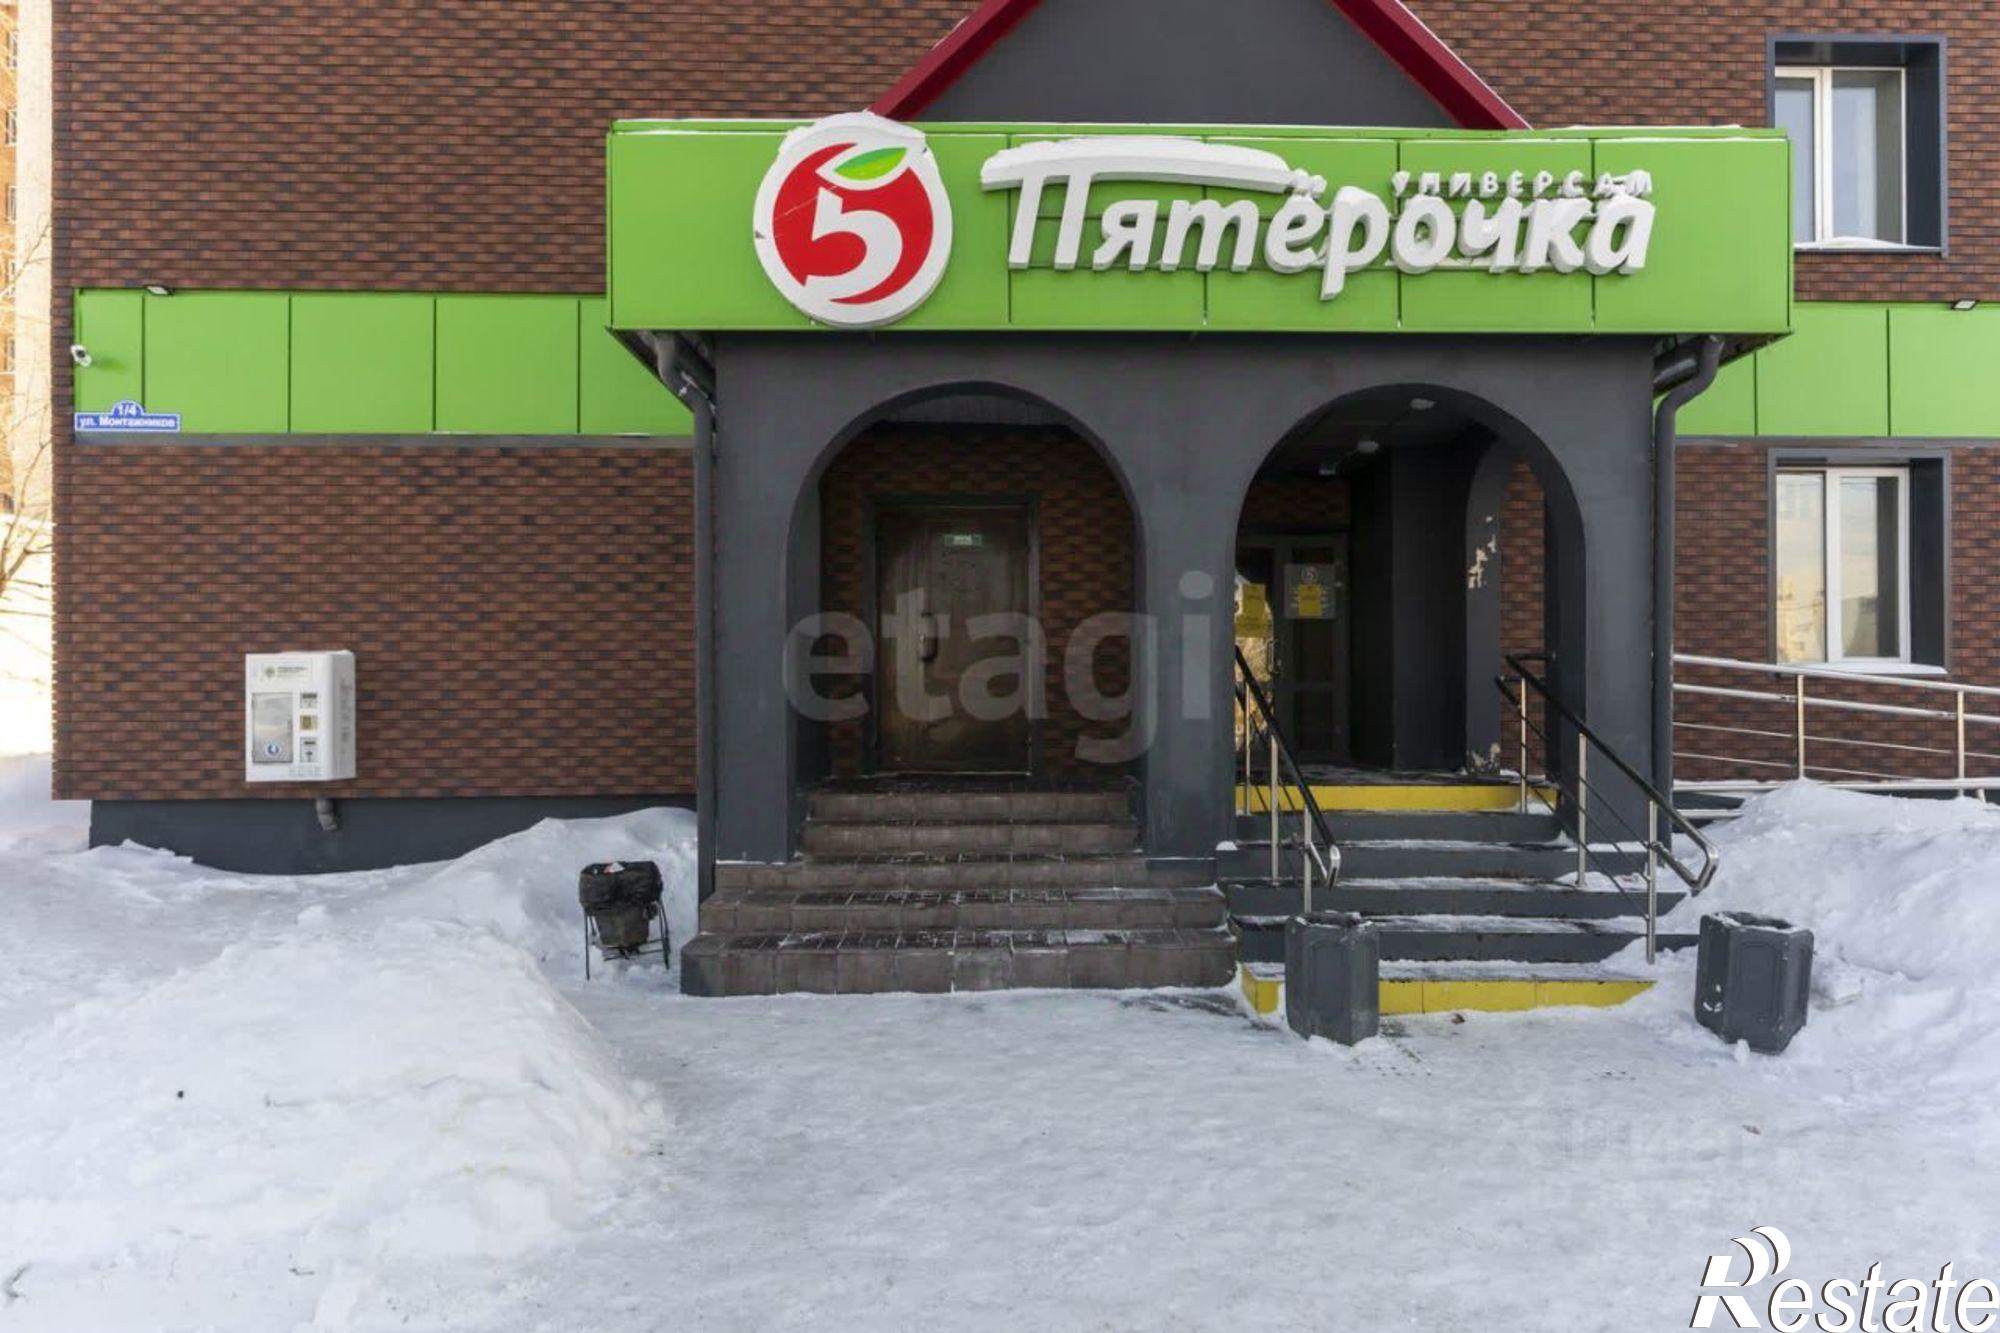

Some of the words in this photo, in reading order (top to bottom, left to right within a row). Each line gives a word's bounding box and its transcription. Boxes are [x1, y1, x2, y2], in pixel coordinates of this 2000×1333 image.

[1391, 170, 1653, 199] УНИВЕРСАМ
[980, 138, 1656, 300] Пятёрочка
[811, 186, 903, 296] 5
[79, 418, 97, 428] ул.
[99, 416, 176, 428] Монтажников
[117, 404, 138, 416] 1/4
